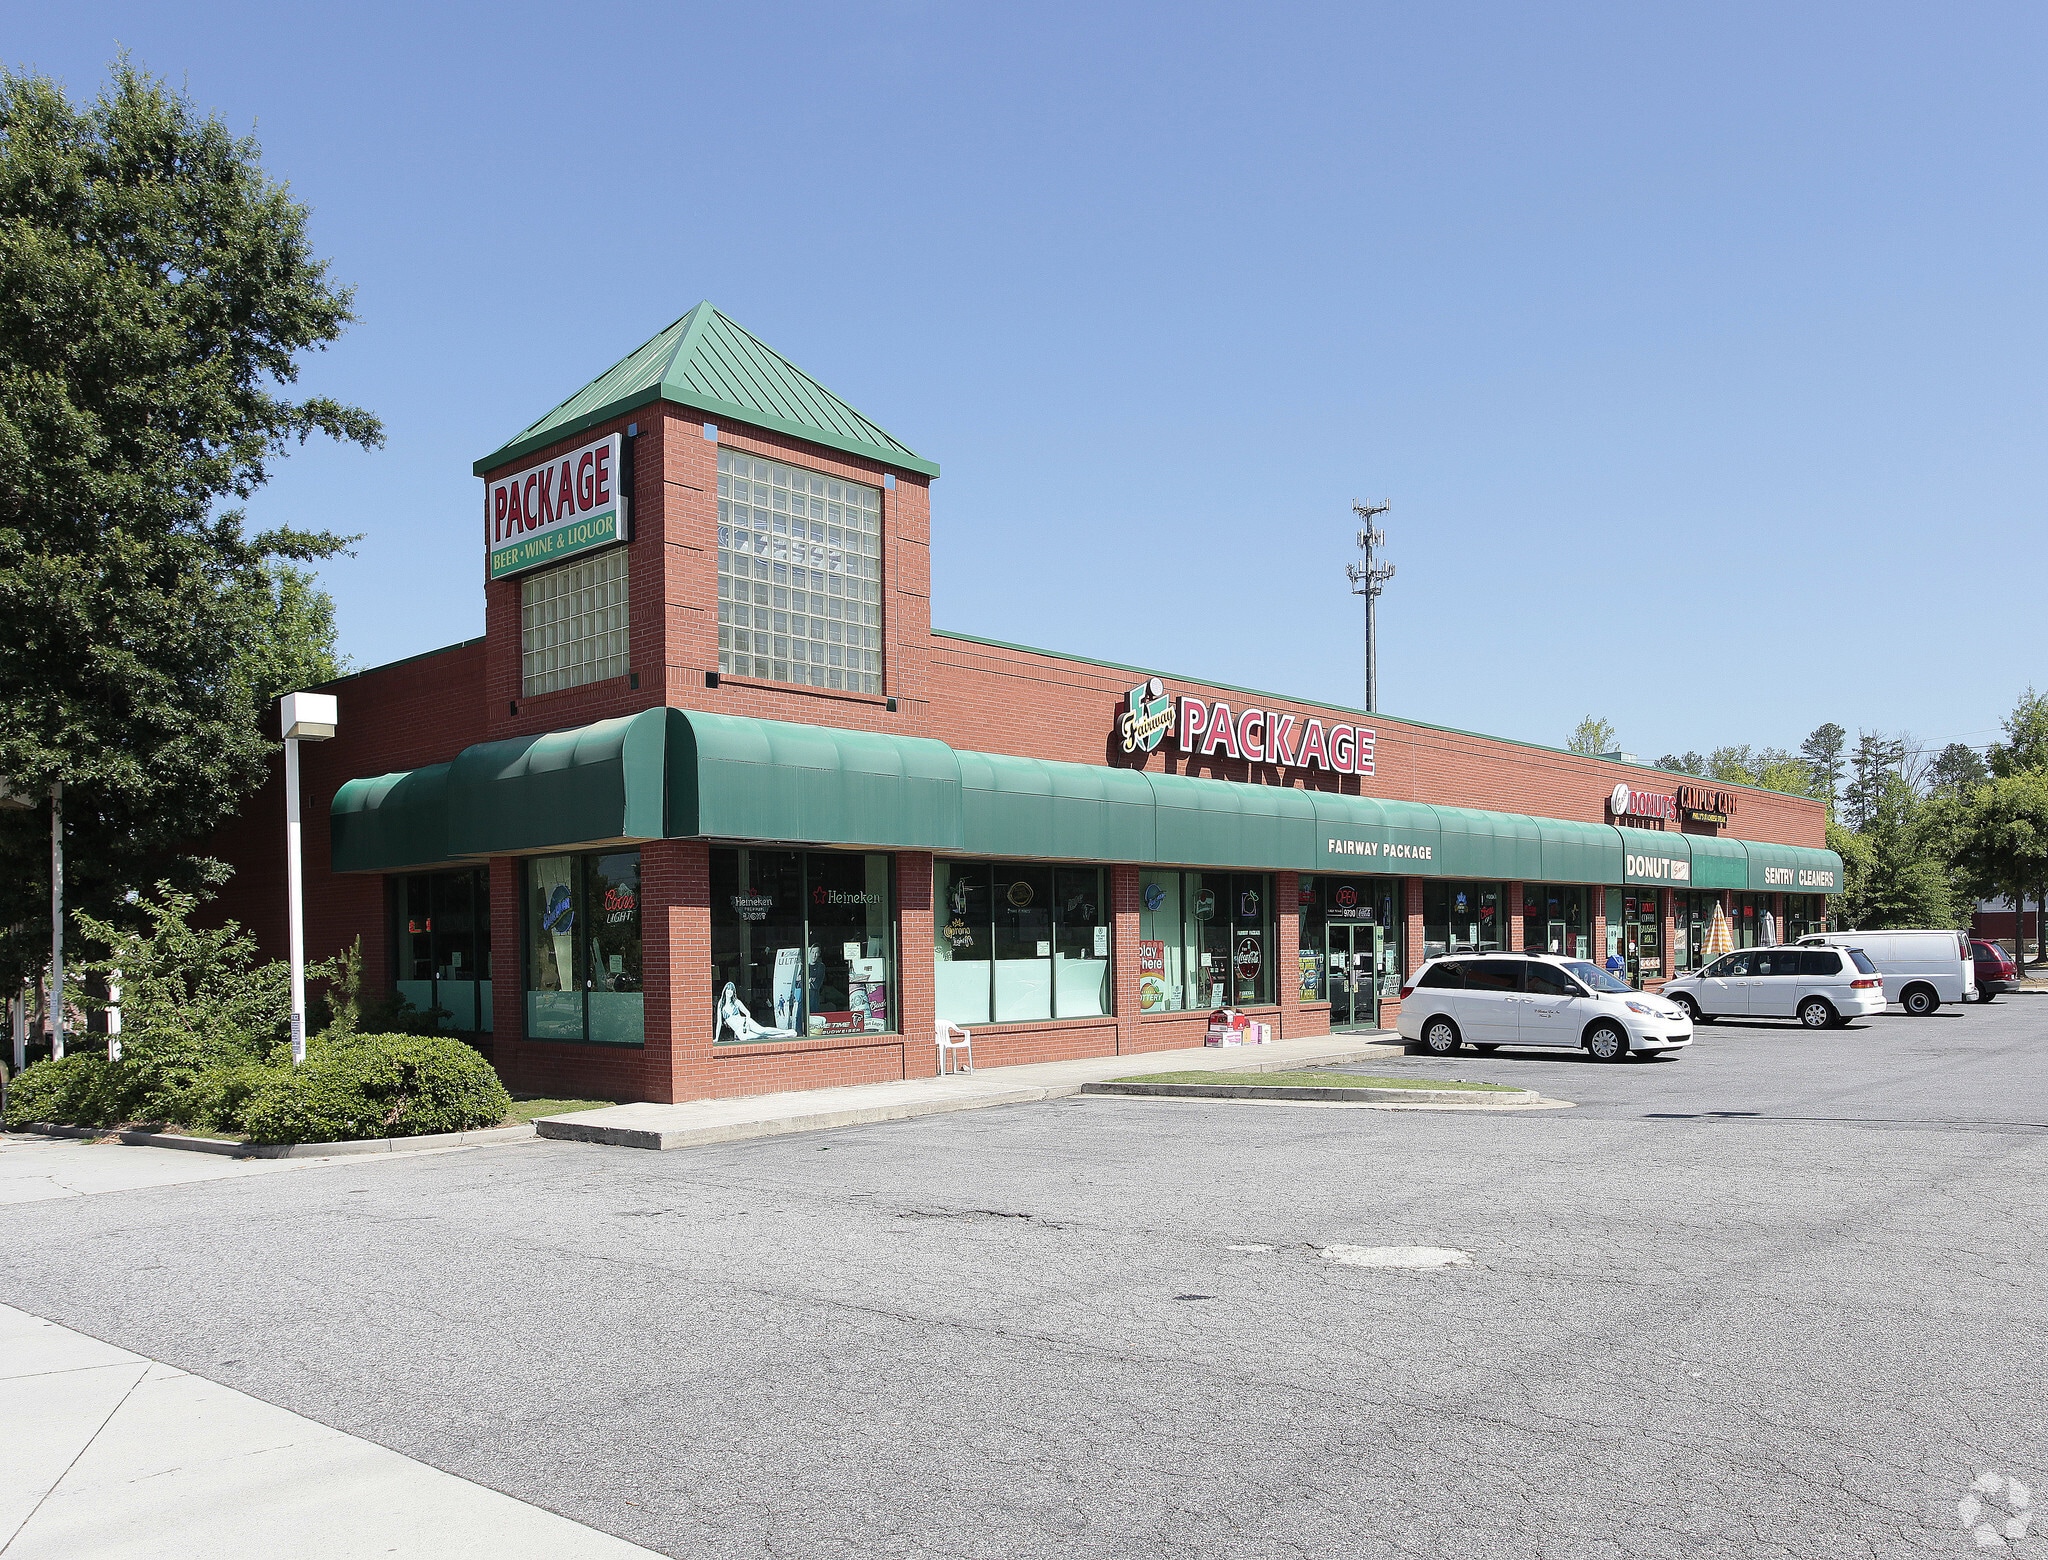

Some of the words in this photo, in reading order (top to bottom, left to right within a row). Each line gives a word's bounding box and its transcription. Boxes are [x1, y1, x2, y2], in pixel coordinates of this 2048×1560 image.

[495, 444, 610, 543] PACKAGE
[493, 548, 519, 571] BEER
[524, 535, 553, 559] WINE
[556, 533, 565, 549] &
[568, 515, 614, 545] LIQUOR
[1121, 704, 1177, 753] Fairway
[1178, 695, 1377, 777] PACKAGE
[1629, 790, 1677, 820] DONUTS
[1681, 785, 1715, 812] CAMPUS
[1328, 838, 1379, 856] FAIRWAY
[1383, 843, 1432, 860] PACKAGE
[1626, 854, 1670, 879] DONUT
[1764, 866, 1795, 885] SENTRY
[1798, 869, 1834, 888] CLEANERS
[734, 896, 773, 907] Heineken
[827, 889, 882, 904] Heineken
[1336, 890, 1358, 904] OPEN
[1343, 909, 1356, 917] 9730
[943, 924, 971, 938] Corona
[1142, 957, 1163, 970] here
